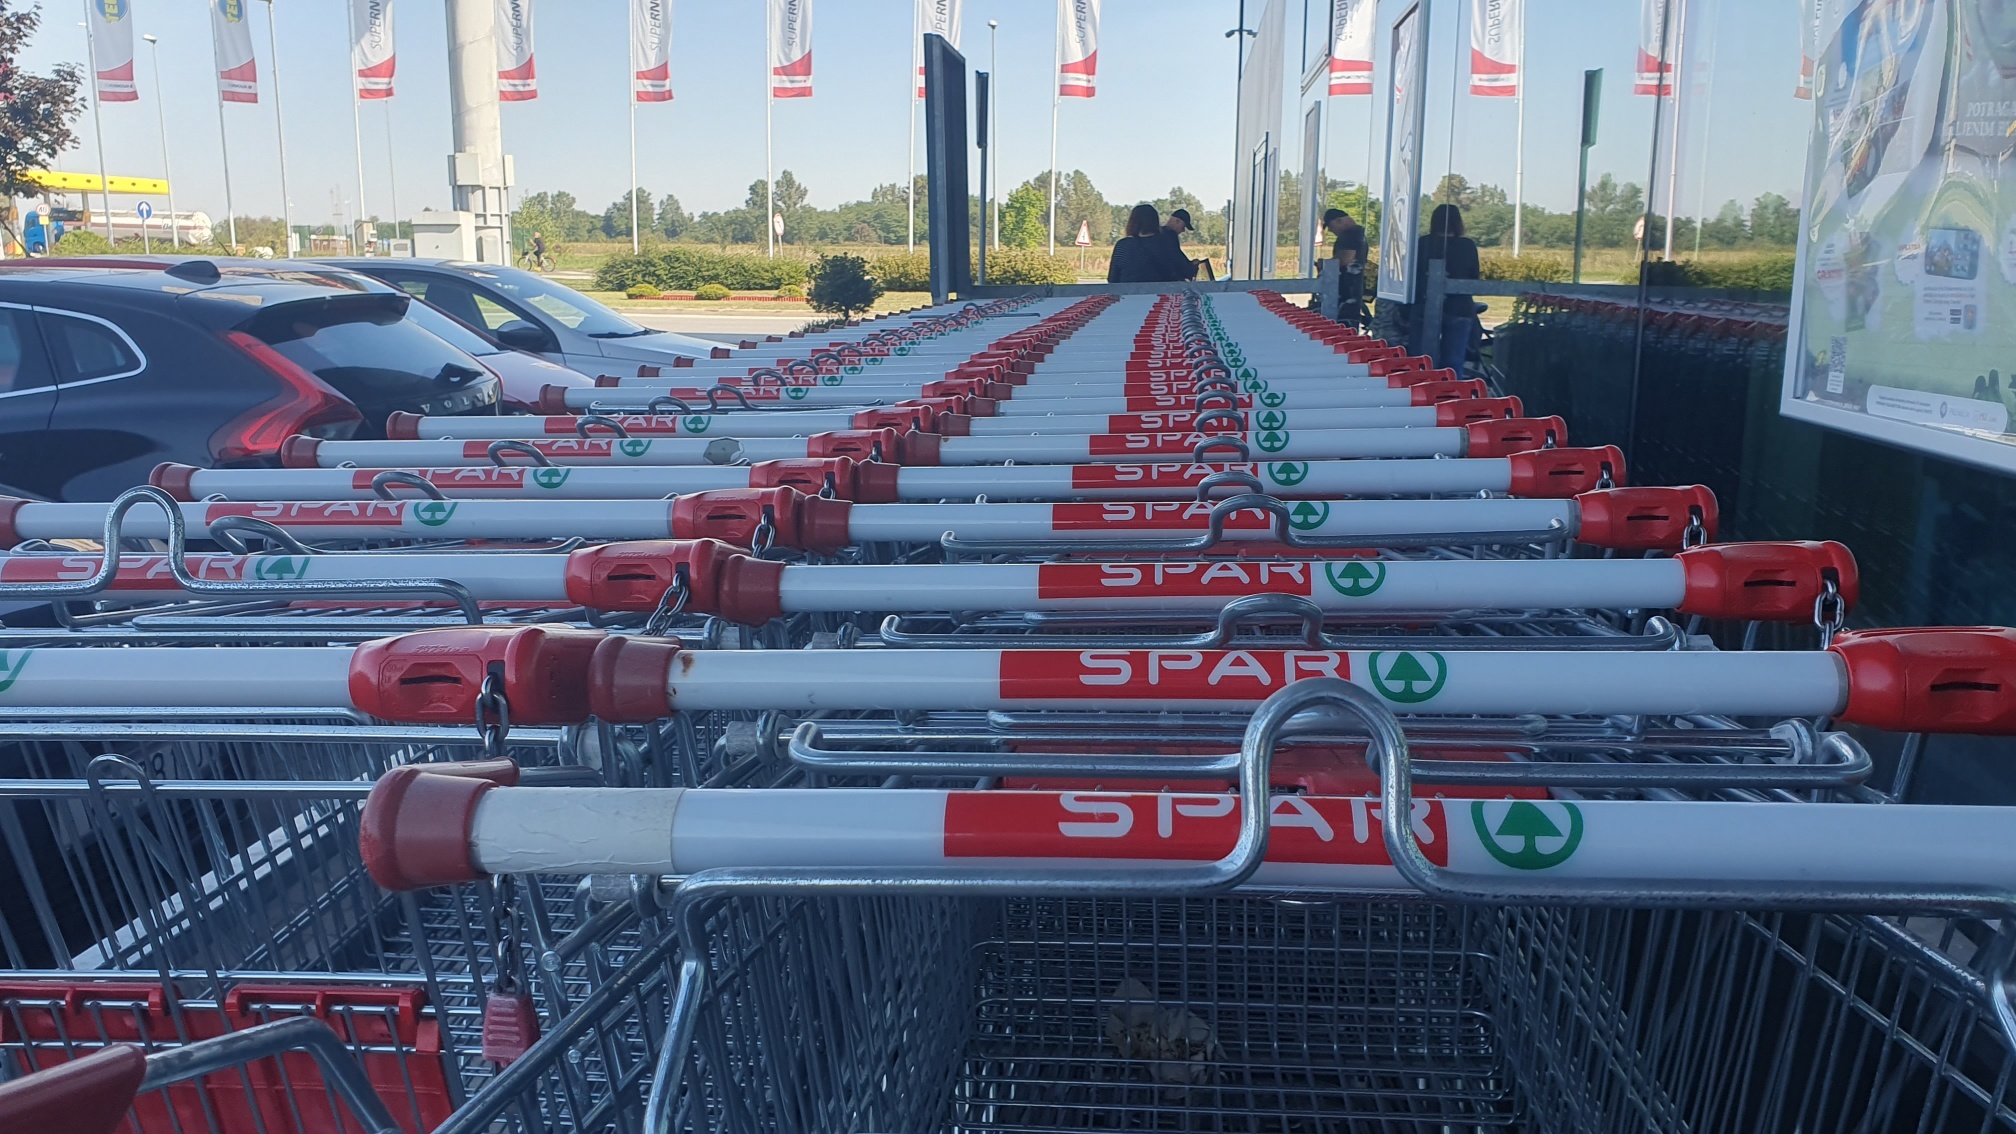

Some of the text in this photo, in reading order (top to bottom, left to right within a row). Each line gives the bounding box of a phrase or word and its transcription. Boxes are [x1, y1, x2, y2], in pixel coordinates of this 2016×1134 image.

[369, 0, 382, 50] SUPERN
[511, 0, 523, 52] SUPERN
[650, 0, 662, 52] SUPERN
[252, 501, 399, 516] SPAR
[1101, 562, 1304, 587] SPAR
[1079, 650, 1341, 687] SPAR
[1058, 791, 1435, 845] SPAR
